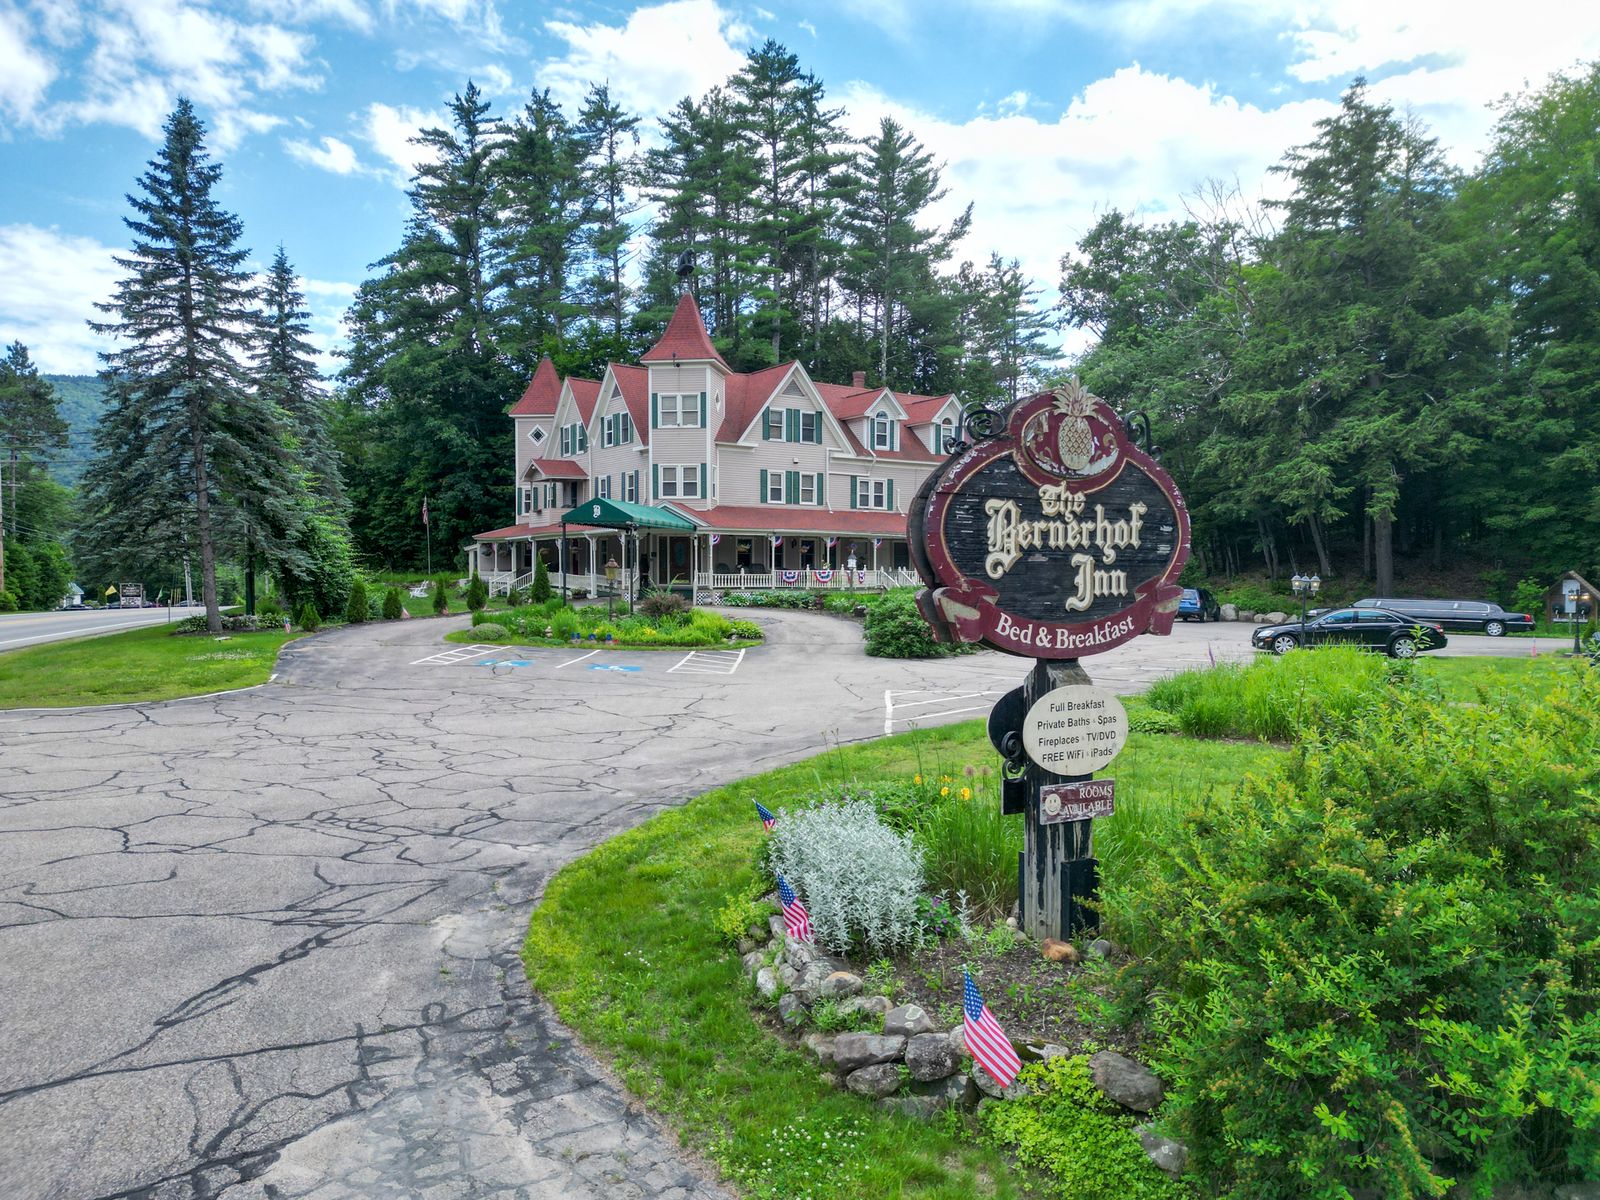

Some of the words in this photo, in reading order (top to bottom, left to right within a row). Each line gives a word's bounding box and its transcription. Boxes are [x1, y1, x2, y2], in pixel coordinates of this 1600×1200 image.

[1038, 480, 1086, 522] The
[985, 498, 1148, 579] Bernerhof
[1065, 553, 1128, 612] Inn
[995, 612, 1033, 644] Bed
[1035, 626, 1052, 647] &
[1055, 615, 1135, 649] Breakfast
[1050, 702, 1065, 713] Full
[1067, 700, 1105, 712] Breakfast
[1037, 718, 1066, 731] Private
[1067, 717, 1090, 727] Baths
[1097, 714, 1117, 726] Spas
[1038, 735, 1080, 748] Fireplaces
[1042, 752, 1064, 763] FREE
[1067, 750, 1084, 760] WiFi
[1091, 747, 1113, 758] iPads
[1079, 785, 1113, 799] ROOMS
[1063, 799, 1113, 815] AVAILABLE
